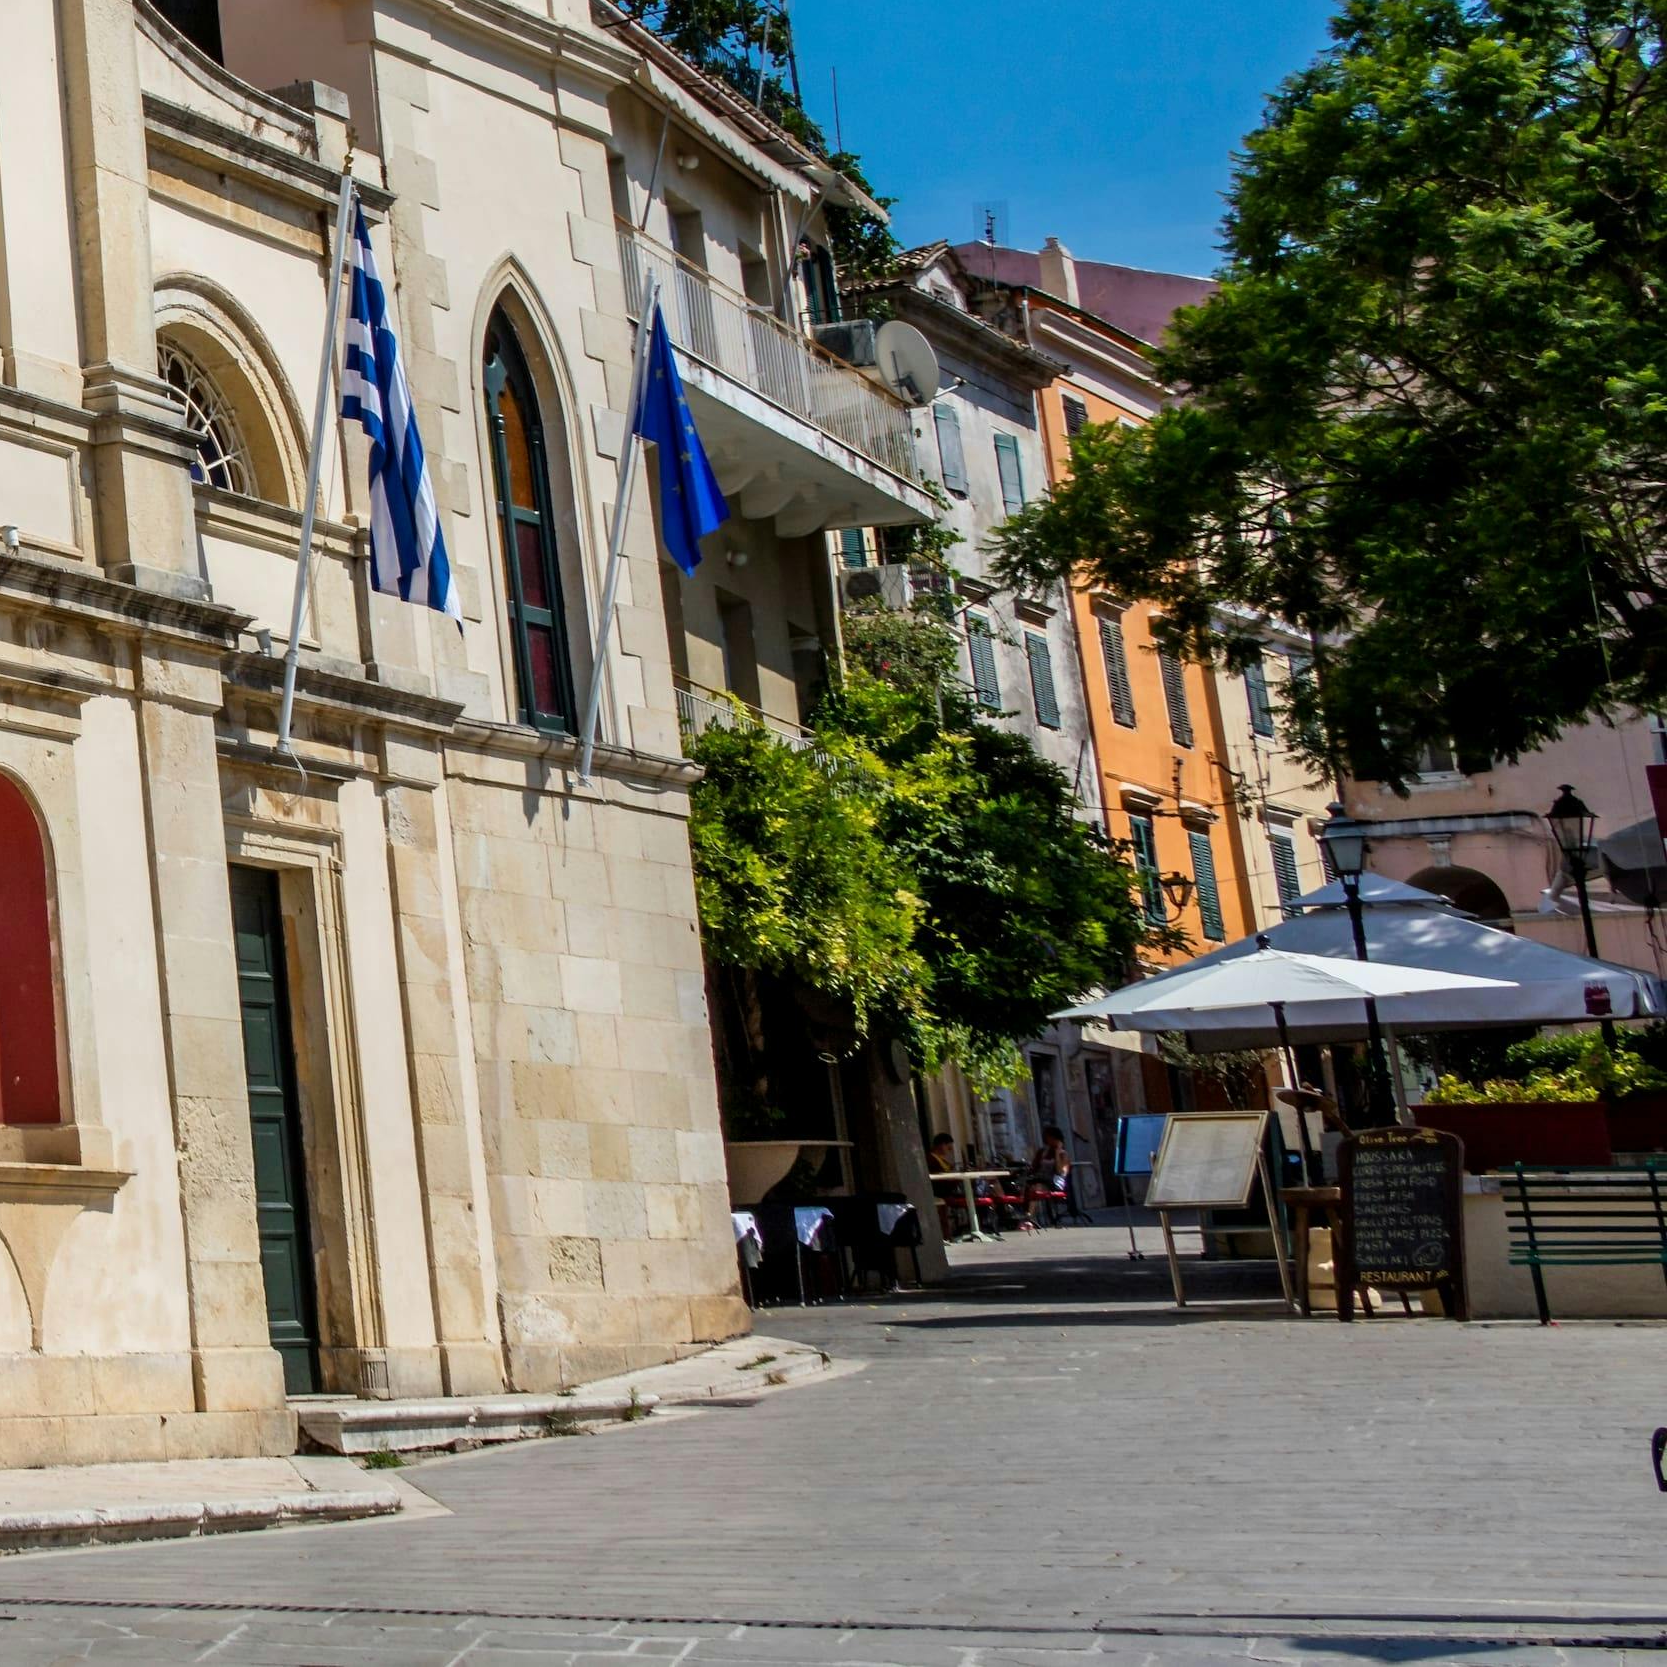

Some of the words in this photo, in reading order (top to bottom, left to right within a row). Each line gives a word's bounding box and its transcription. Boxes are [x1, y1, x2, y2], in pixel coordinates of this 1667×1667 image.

[1359, 1135, 1384, 1144] Olive
[1387, 1131, 1407, 1143] Tree
[1360, 1271, 1432, 1283] RESTAURANT
